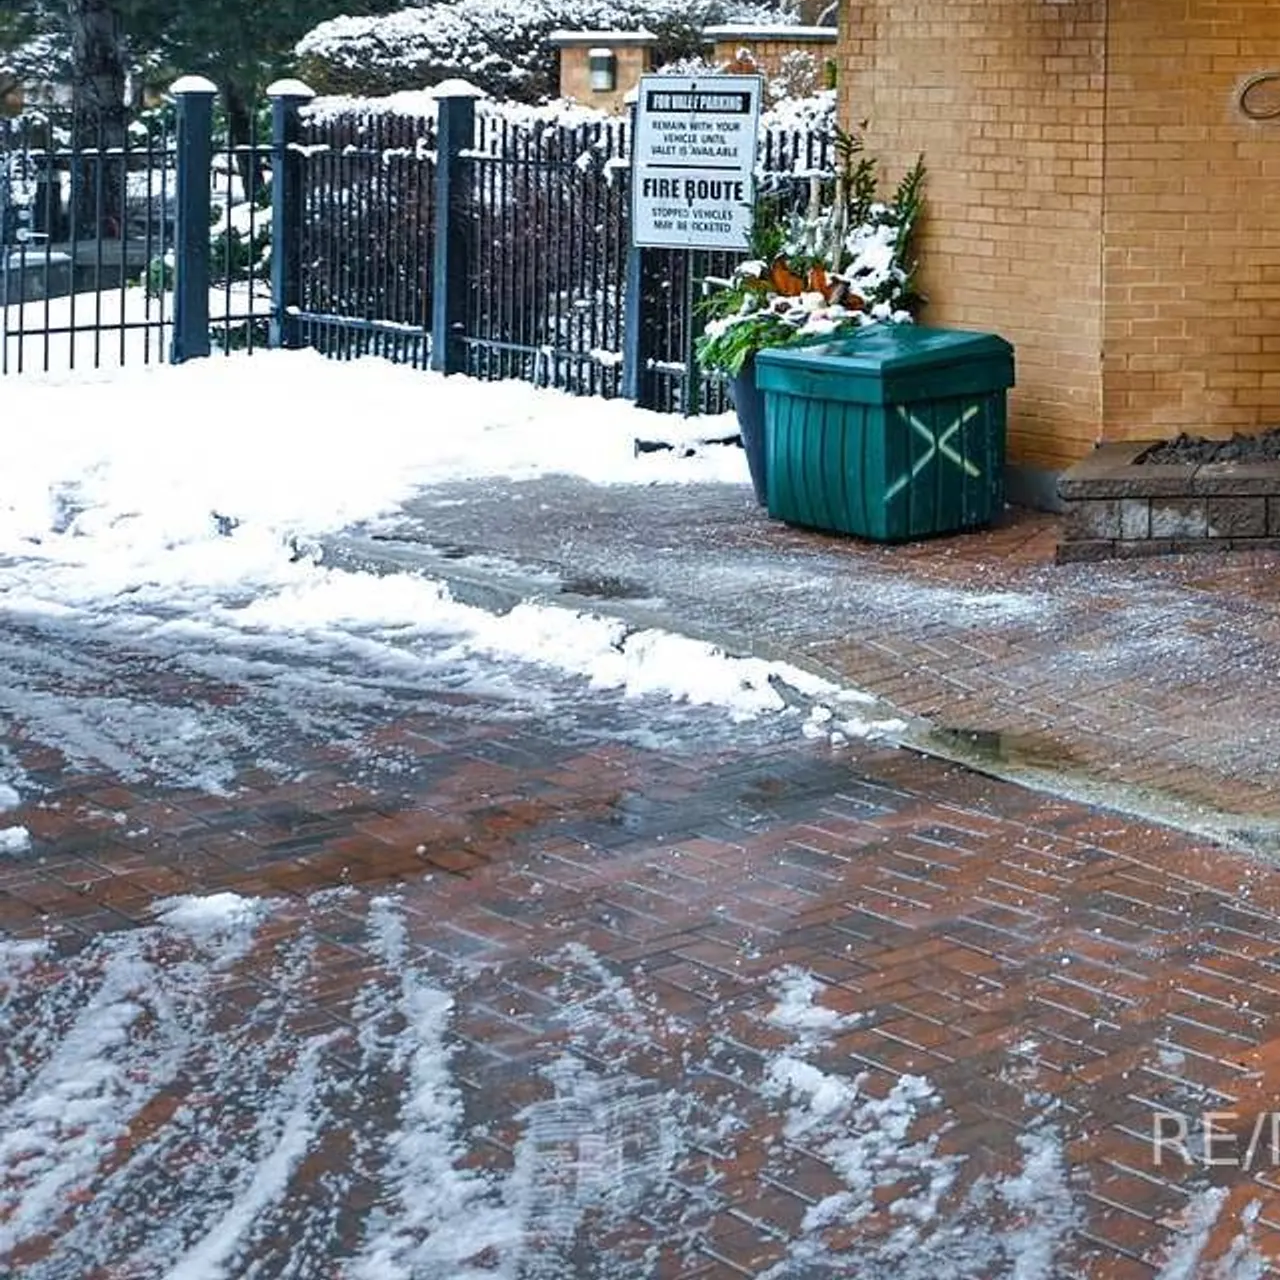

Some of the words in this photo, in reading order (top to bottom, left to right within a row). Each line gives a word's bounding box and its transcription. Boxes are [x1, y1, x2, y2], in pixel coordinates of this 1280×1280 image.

[652, 121, 687, 131] REMAIN
[690, 122, 713, 131] WITH
[716, 122, 740, 132] YOUR
[664, 134, 697, 144] VEHICLE
[651, 146, 676, 155] VALET
[680, 146, 689, 155] IS
[690, 147, 738, 157] AVAILABLE
[643, 178, 680, 198] FIRE
[685, 179, 744, 200] ROUTE
[652, 207, 689, 218] STOPPED
[692, 209, 733, 220] VEHICLES
